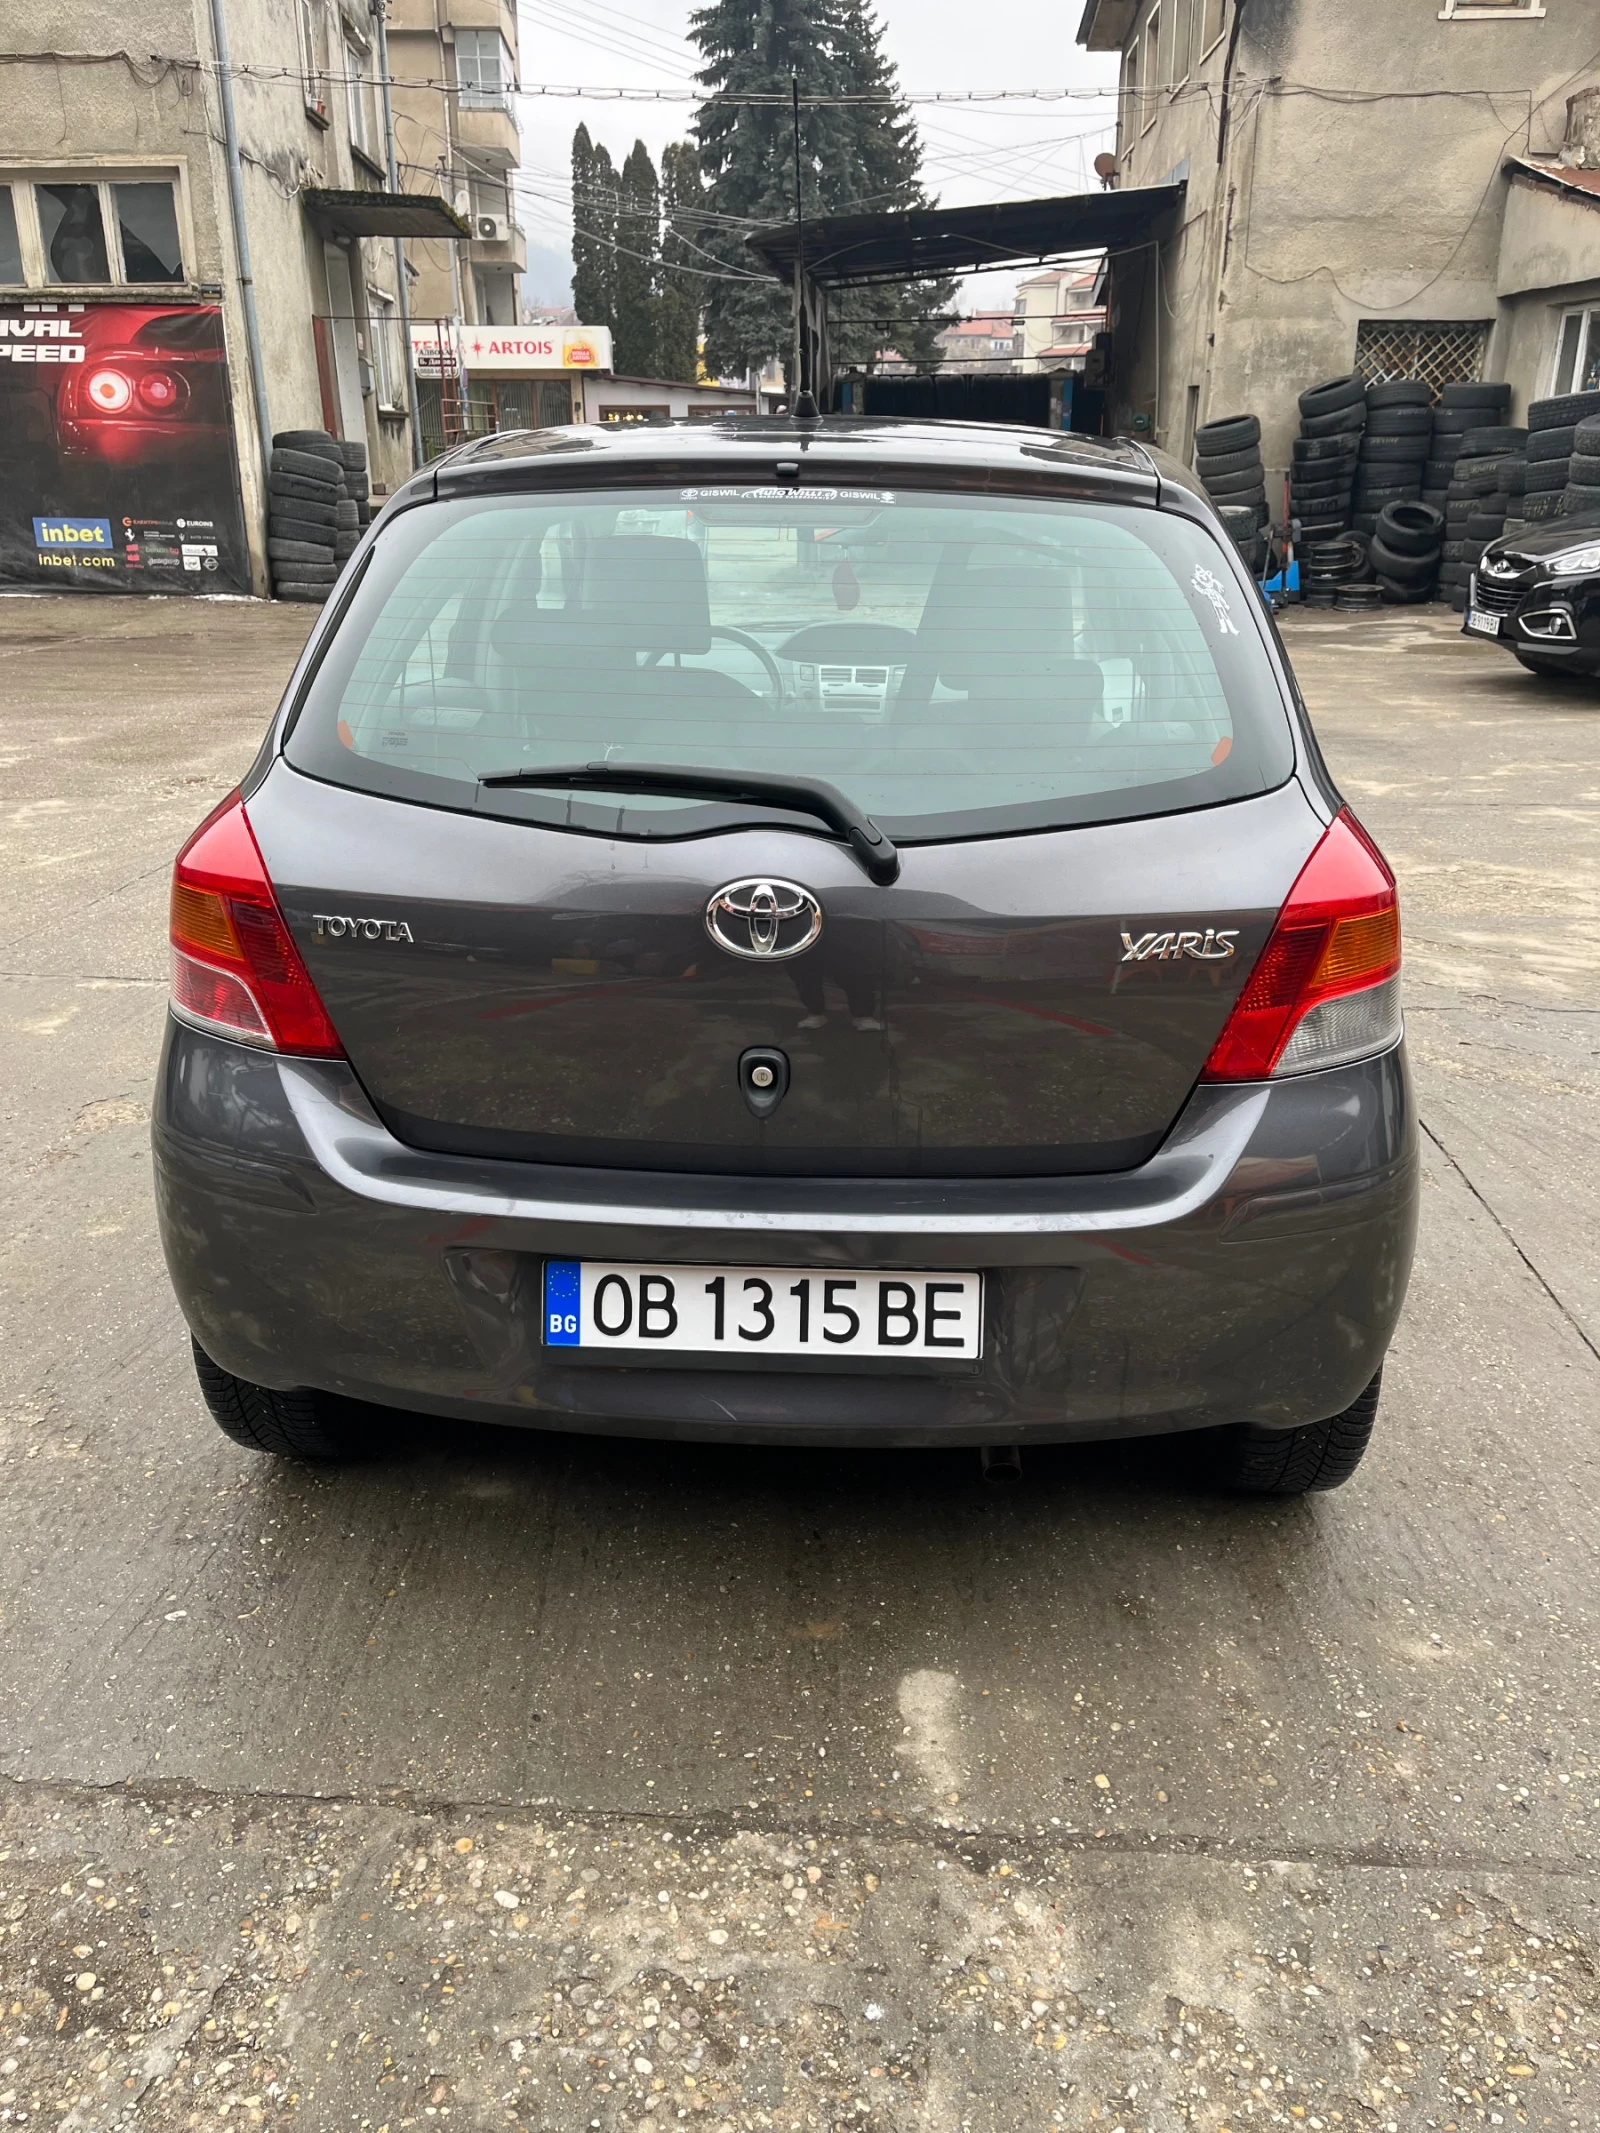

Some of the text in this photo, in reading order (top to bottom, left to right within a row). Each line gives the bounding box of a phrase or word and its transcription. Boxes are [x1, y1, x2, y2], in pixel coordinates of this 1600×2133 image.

[489, 341, 553, 355] ARTOIS
[700, 489, 740, 497] GISWIL
[840, 491, 881, 500] GISWIL
[41, 522, 105, 543] inbet
[186, 520, 214, 528] EUROINS
[38, 553, 116, 568] inbet.com
[312, 914, 415, 943] TOYOTA
[704, 1275, 861, 1344] 1315
[877, 1280, 966, 1348] BE
[549, 1313, 578, 1334] BG
